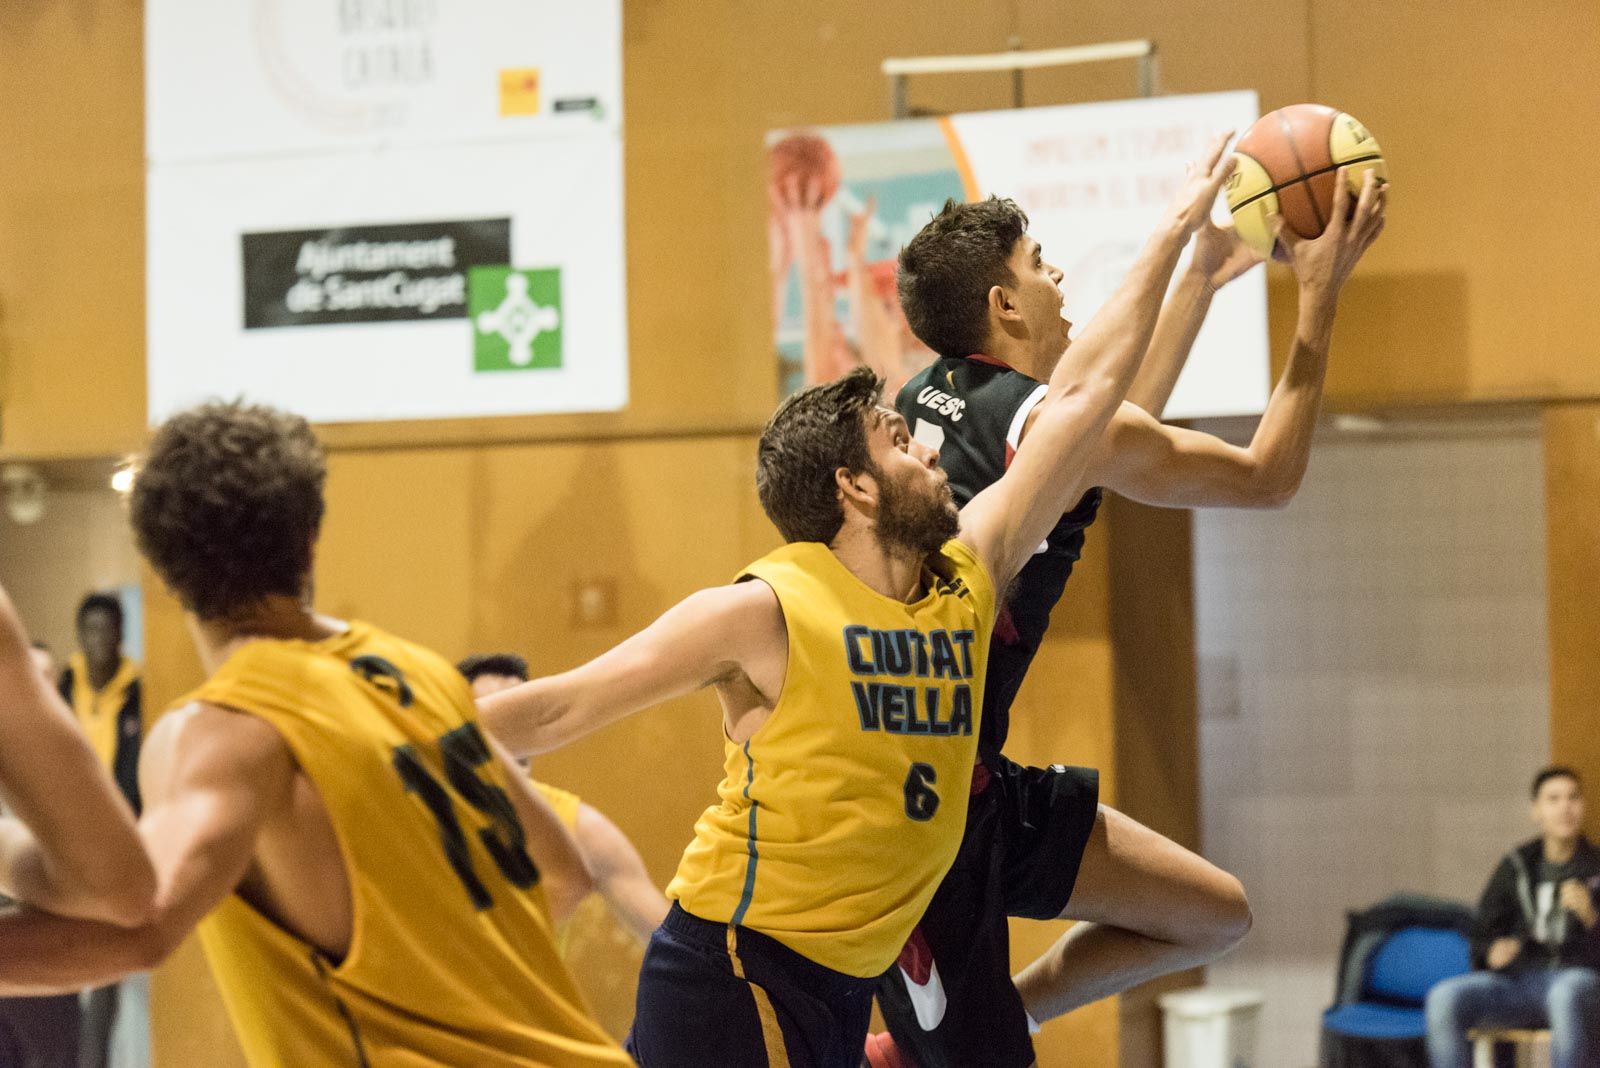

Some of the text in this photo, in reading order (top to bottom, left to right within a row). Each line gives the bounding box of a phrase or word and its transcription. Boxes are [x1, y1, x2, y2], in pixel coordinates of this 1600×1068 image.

[296, 236, 456, 280] Ajuntament
[286, 280, 323, 313] de
[916, 385, 966, 422] UESC
[843, 624, 975, 680] CIUTAT
[850, 681, 974, 736] VELLA
[392, 720, 541, 912] 15
[903, 761, 940, 822] 6
